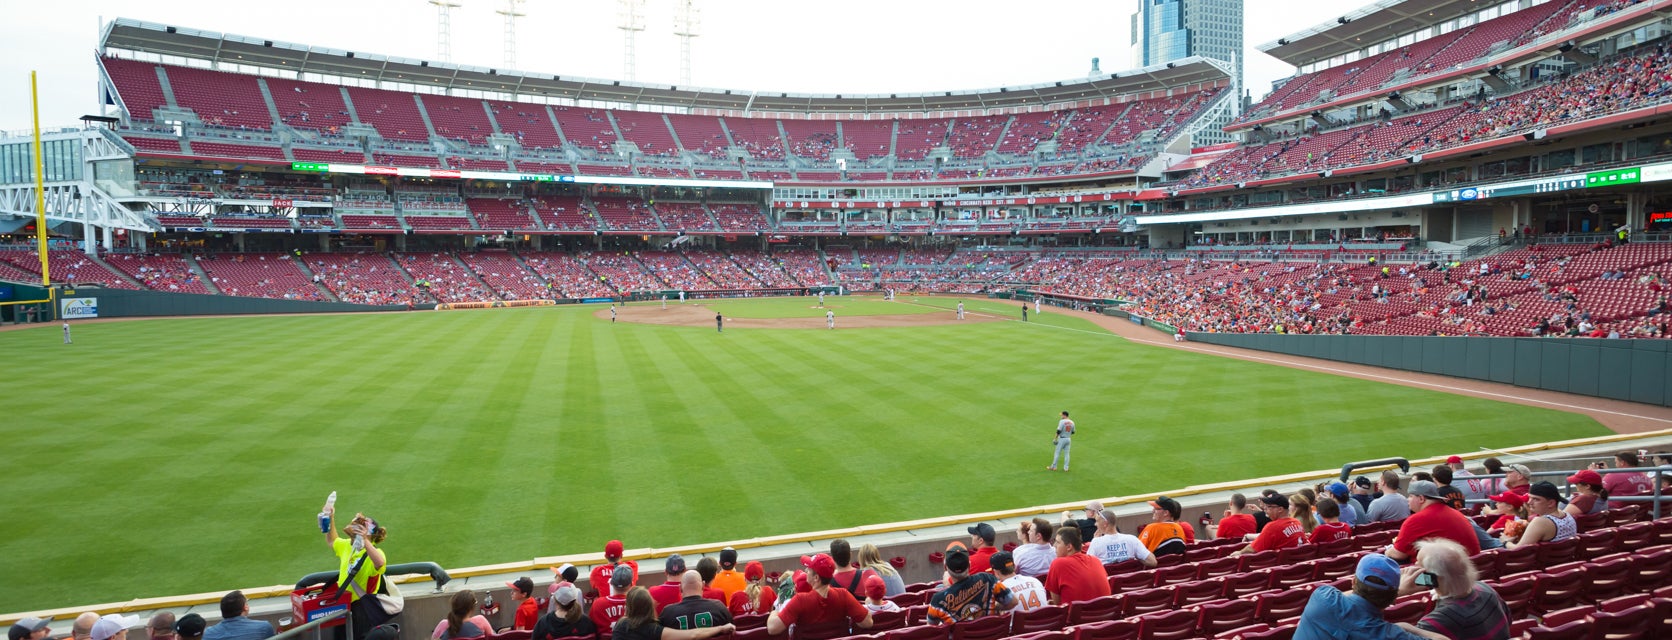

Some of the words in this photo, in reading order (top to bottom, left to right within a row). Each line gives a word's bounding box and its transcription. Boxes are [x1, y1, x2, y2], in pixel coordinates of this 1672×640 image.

[67, 307, 82, 315] ARC
[1106, 544, 1121, 552] KEEP
[945, 580, 985, 609] Baltimore
[1018, 590, 1042, 611] 14
